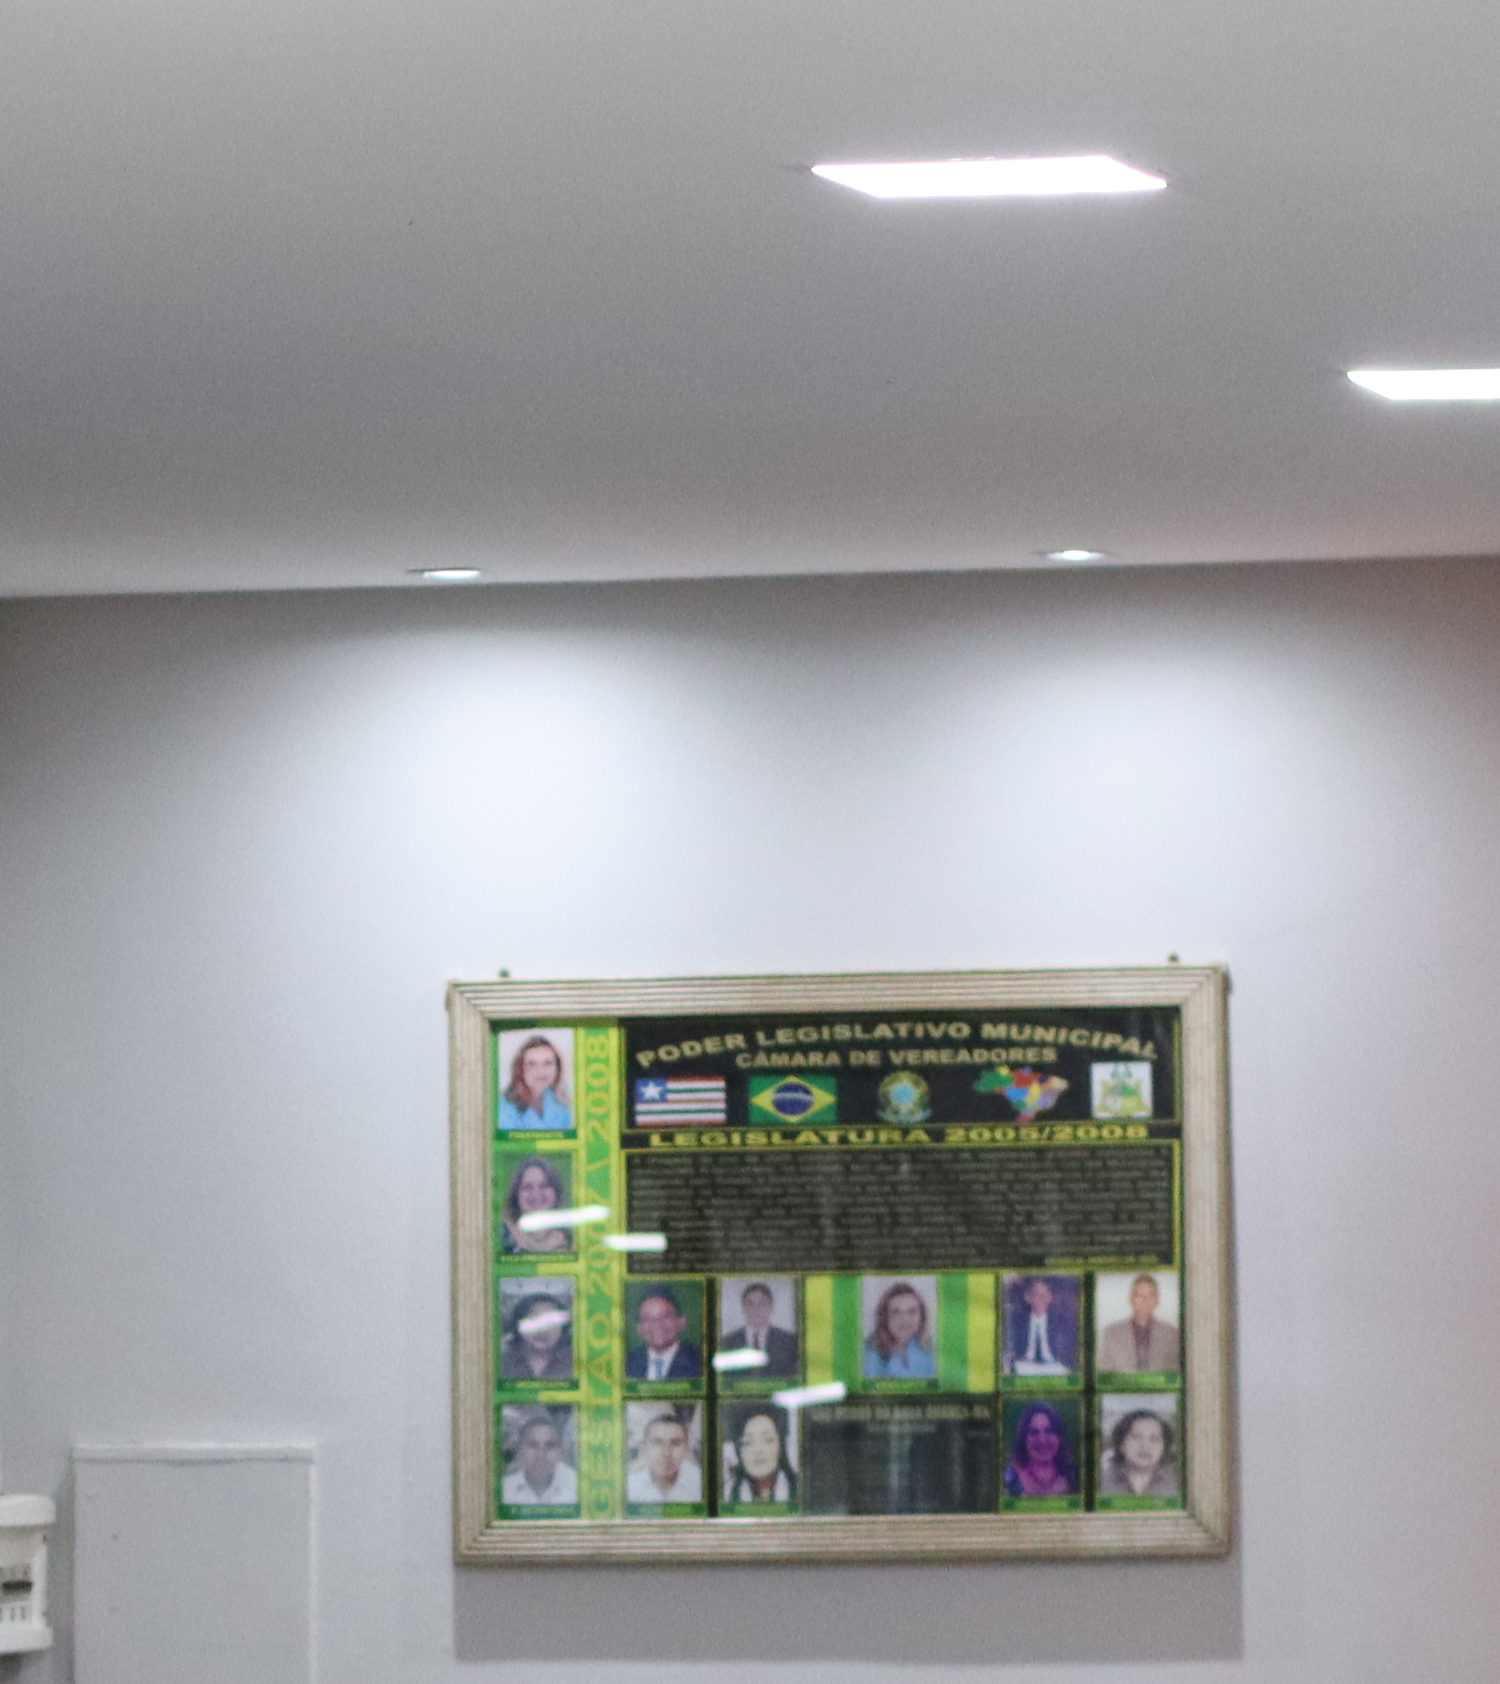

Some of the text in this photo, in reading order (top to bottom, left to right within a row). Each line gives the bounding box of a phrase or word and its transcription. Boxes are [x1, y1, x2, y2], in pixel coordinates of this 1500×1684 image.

[635, 1021, 1159, 1069] PODER LEGISLATIVO MUNICIPAL
[849, 1049, 882, 1067] DE
[889, 1046, 1058, 1065] VEREADORES
[586, 1033, 611, 1144] 2008
[650, 1125, 1149, 1147] LEGISLATURA 2005/2008
